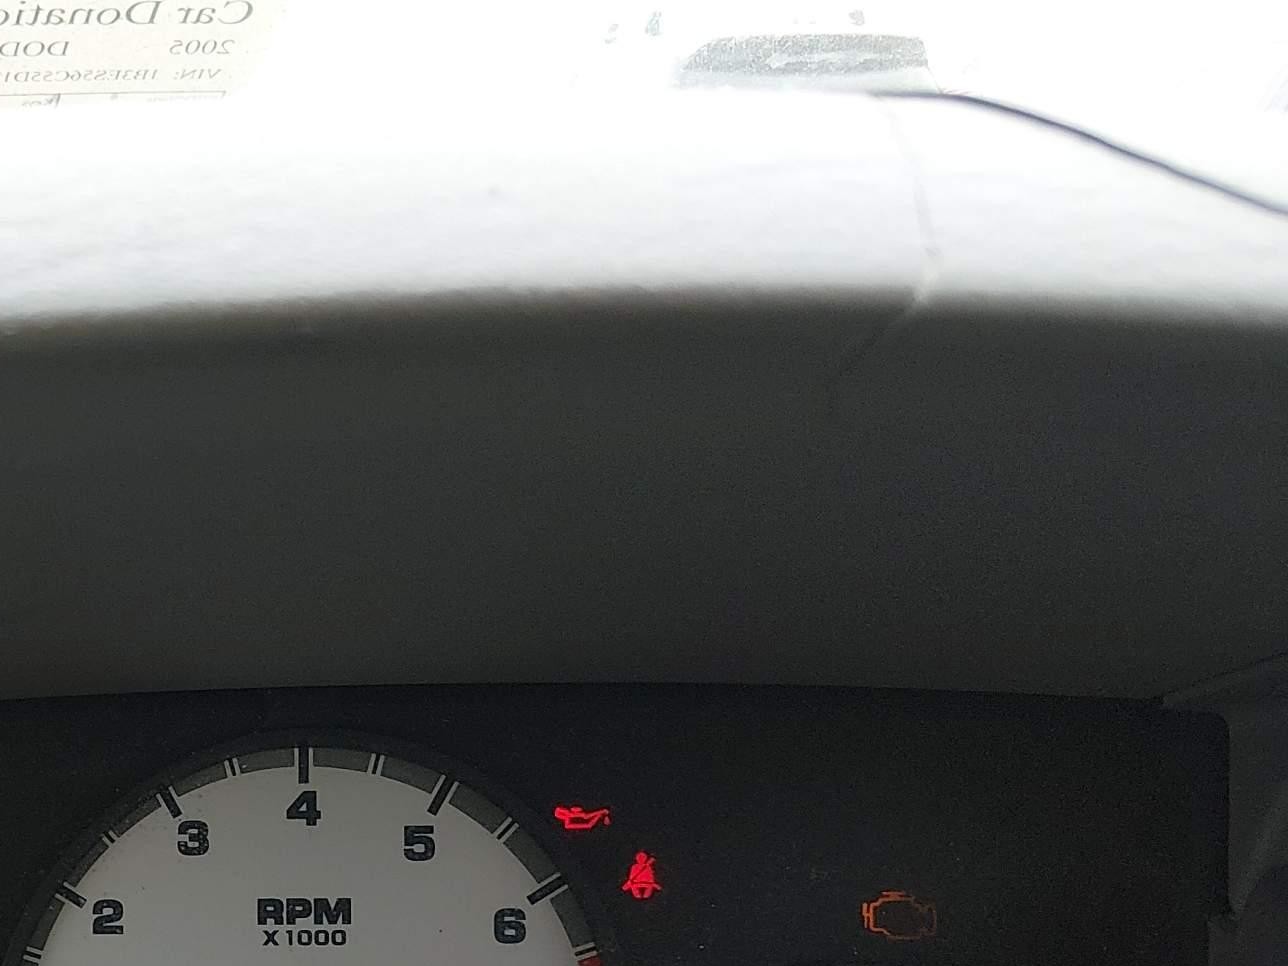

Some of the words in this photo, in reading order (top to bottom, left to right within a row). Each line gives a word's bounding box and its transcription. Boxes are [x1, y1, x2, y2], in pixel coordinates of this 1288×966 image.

[286, 791, 321, 826] 4
[177, 820, 210, 856] 3
[403, 825, 435, 862] 5
[92, 899, 124, 935] 2
[256, 897, 352, 926] RPM
[493, 907, 526, 944] 6
